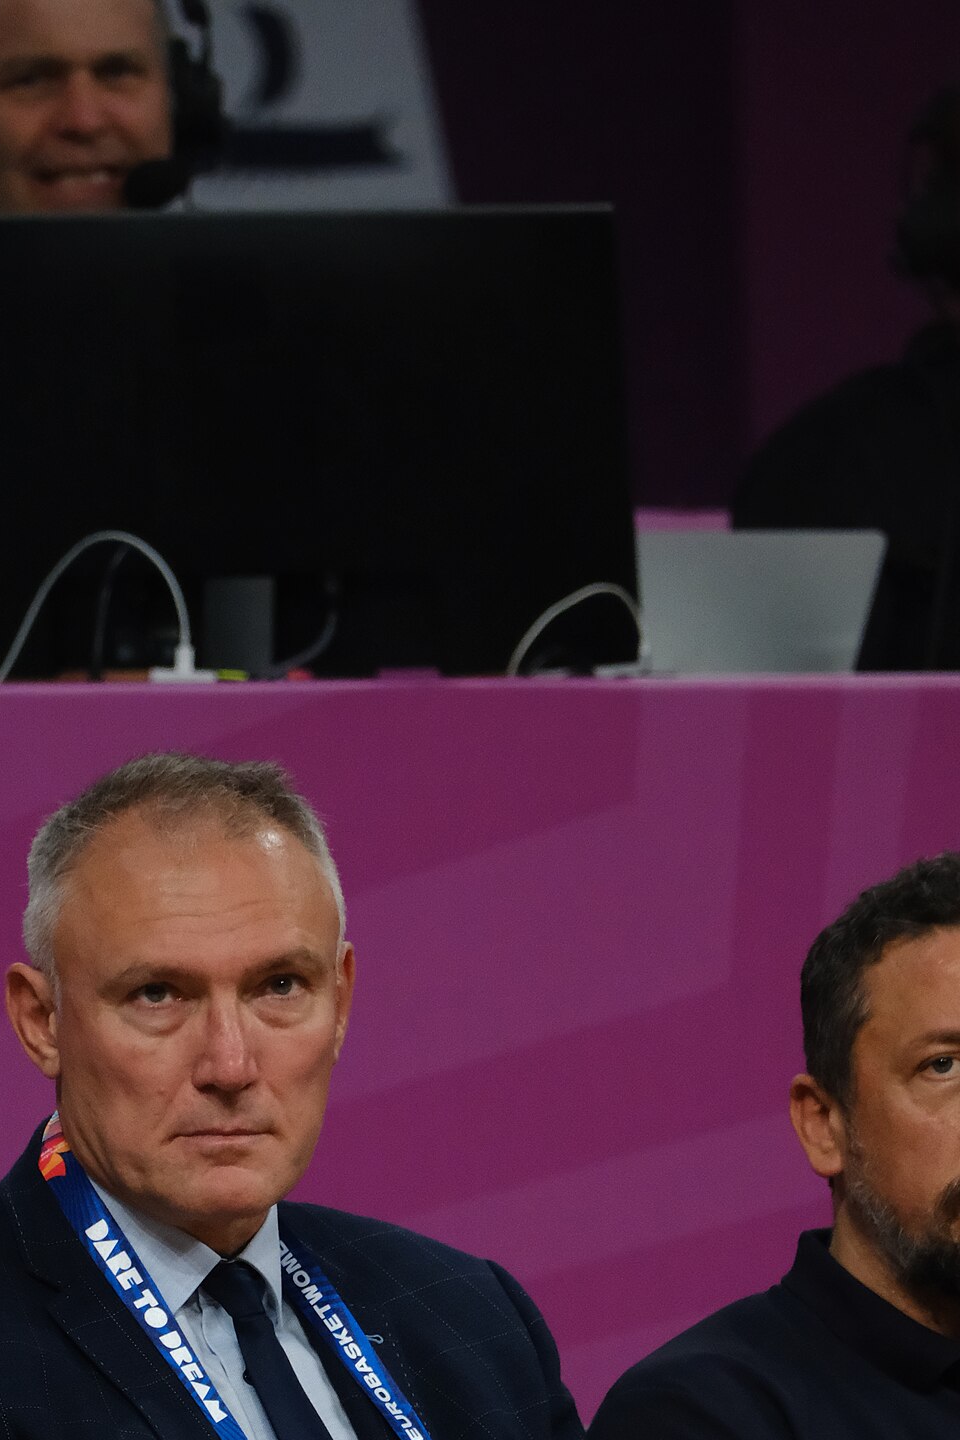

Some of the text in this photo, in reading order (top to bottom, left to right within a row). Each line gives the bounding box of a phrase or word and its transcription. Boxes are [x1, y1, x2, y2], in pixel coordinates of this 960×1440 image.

[84, 1218, 228, 1424] DARE TO DREAM
